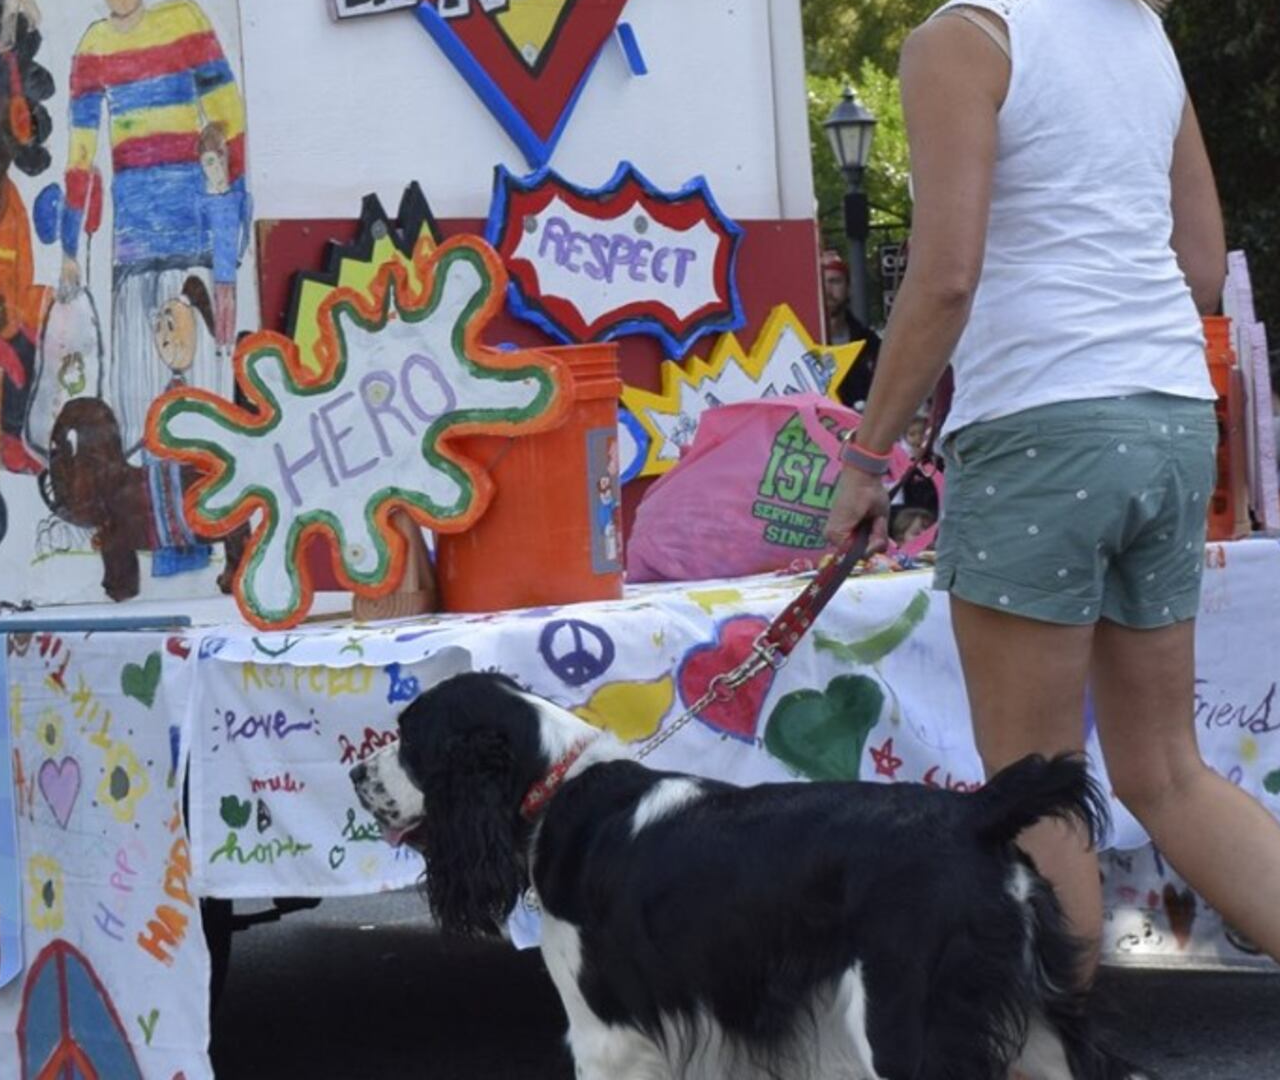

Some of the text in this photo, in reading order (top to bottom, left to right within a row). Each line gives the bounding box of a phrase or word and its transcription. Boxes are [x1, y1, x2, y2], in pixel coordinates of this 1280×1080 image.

[538, 216, 697, 288] RESPECT
[273, 353, 457, 507] HERO
[757, 446, 837, 512] ISL
